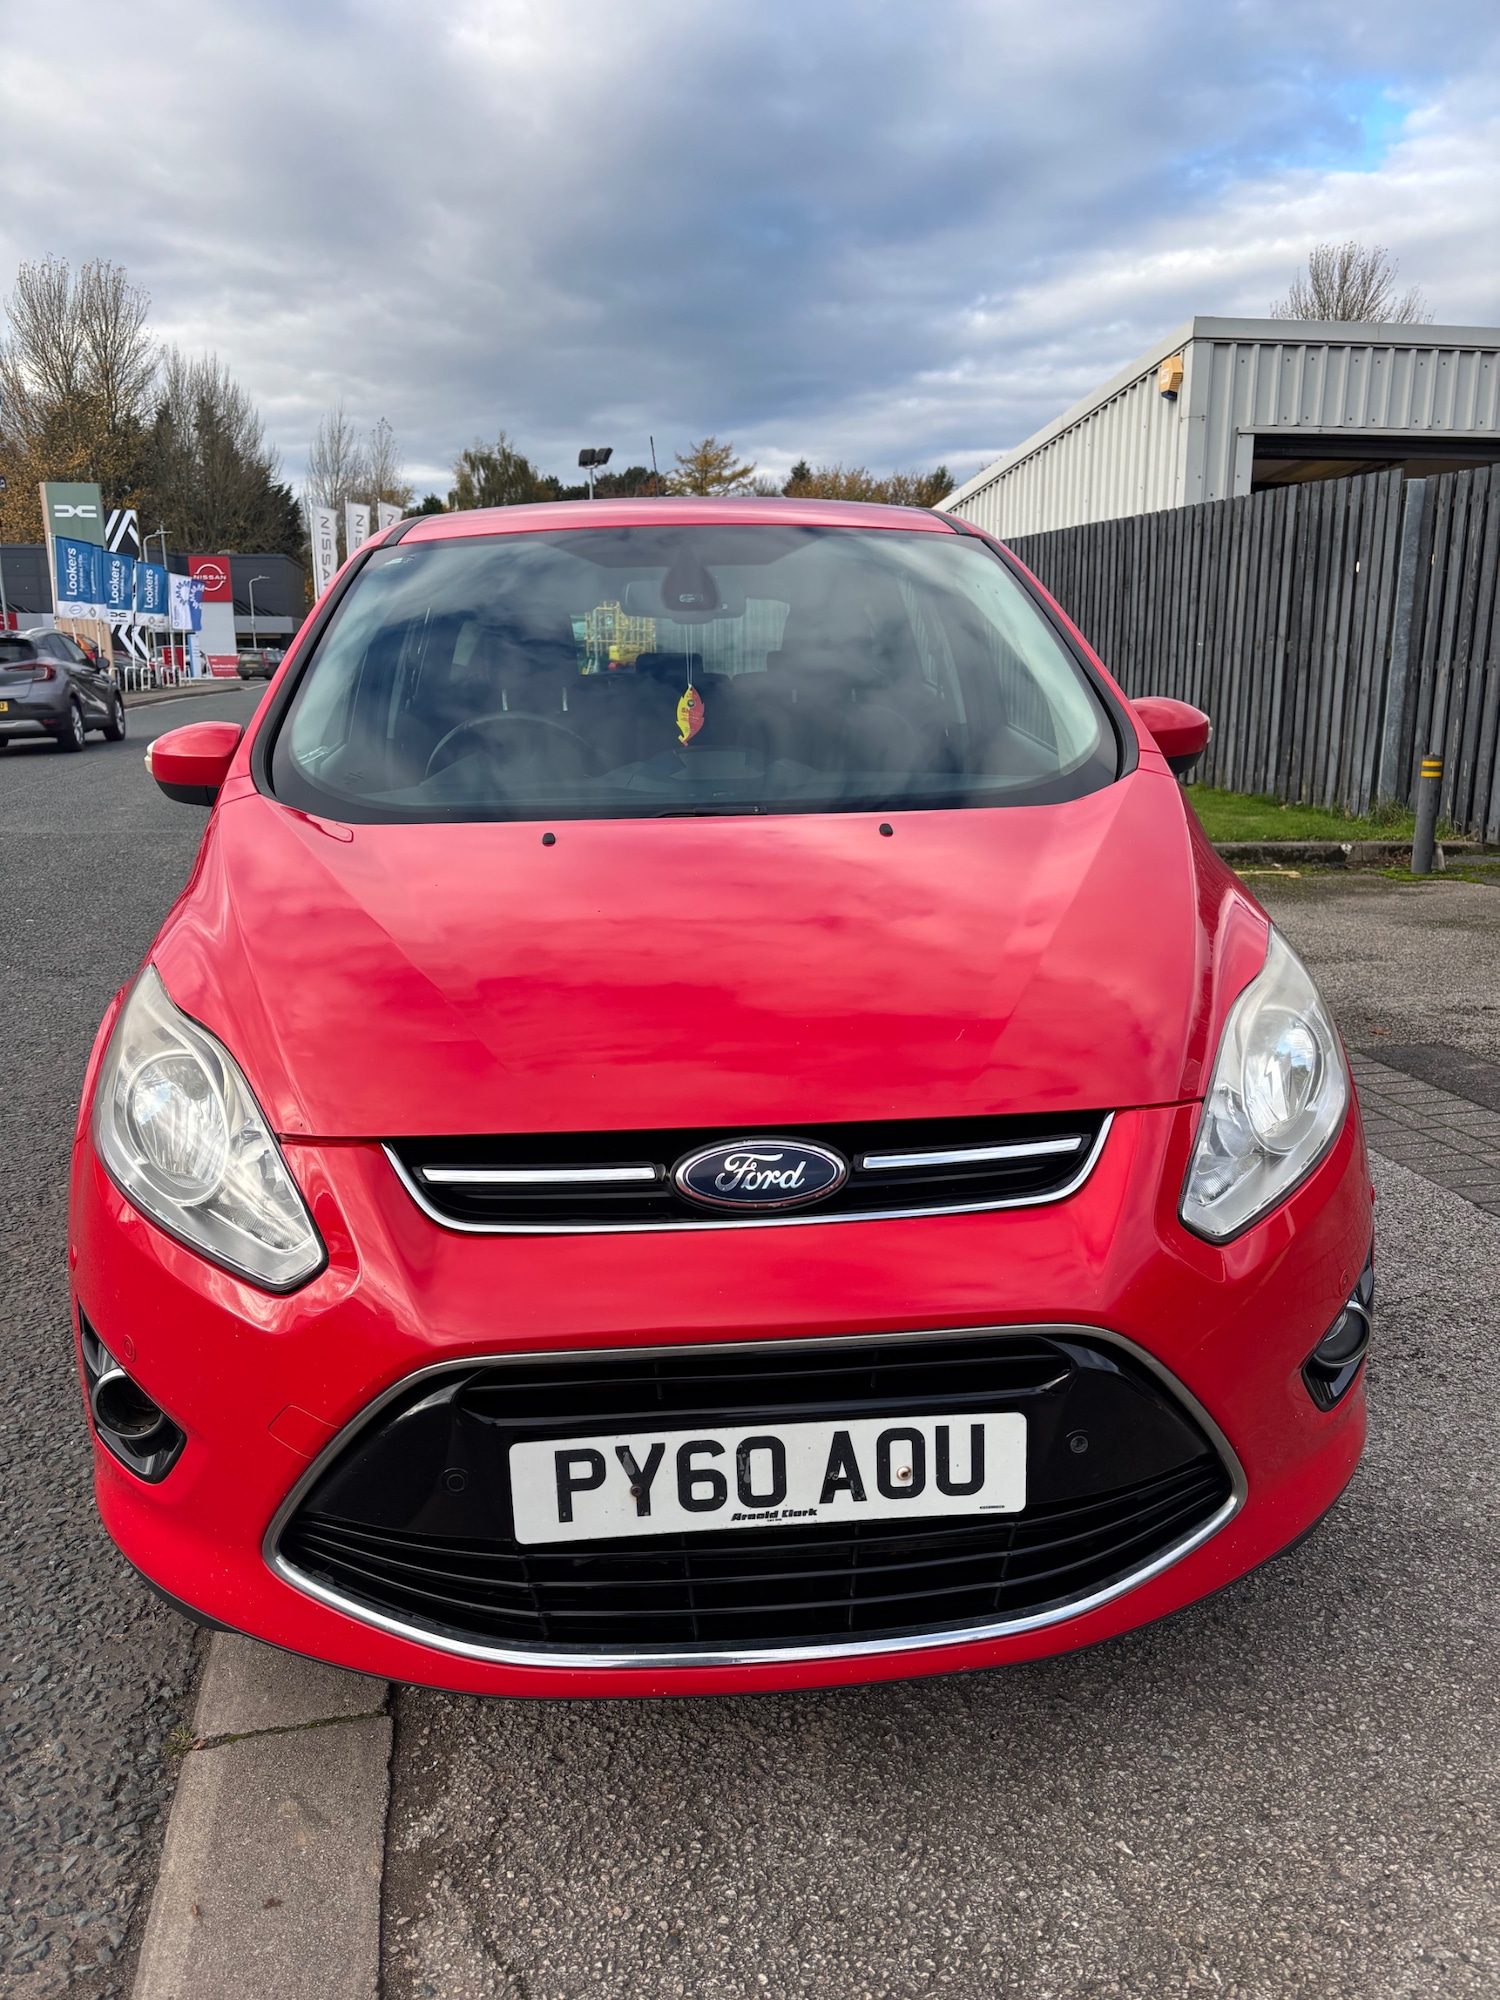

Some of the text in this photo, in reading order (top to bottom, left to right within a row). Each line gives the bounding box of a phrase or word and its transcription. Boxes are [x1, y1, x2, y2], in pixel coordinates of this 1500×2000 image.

[66, 547, 78, 596] Lookers
[320, 516, 332, 587] NISSA
[109, 560, 121, 604] Lookers
[144, 569, 154, 609] Lookers
[714, 1153, 808, 1192] Ford
[555, 1424, 985, 1523] PY60 AOU
[731, 1508, 818, 1521] Arnold Clark
